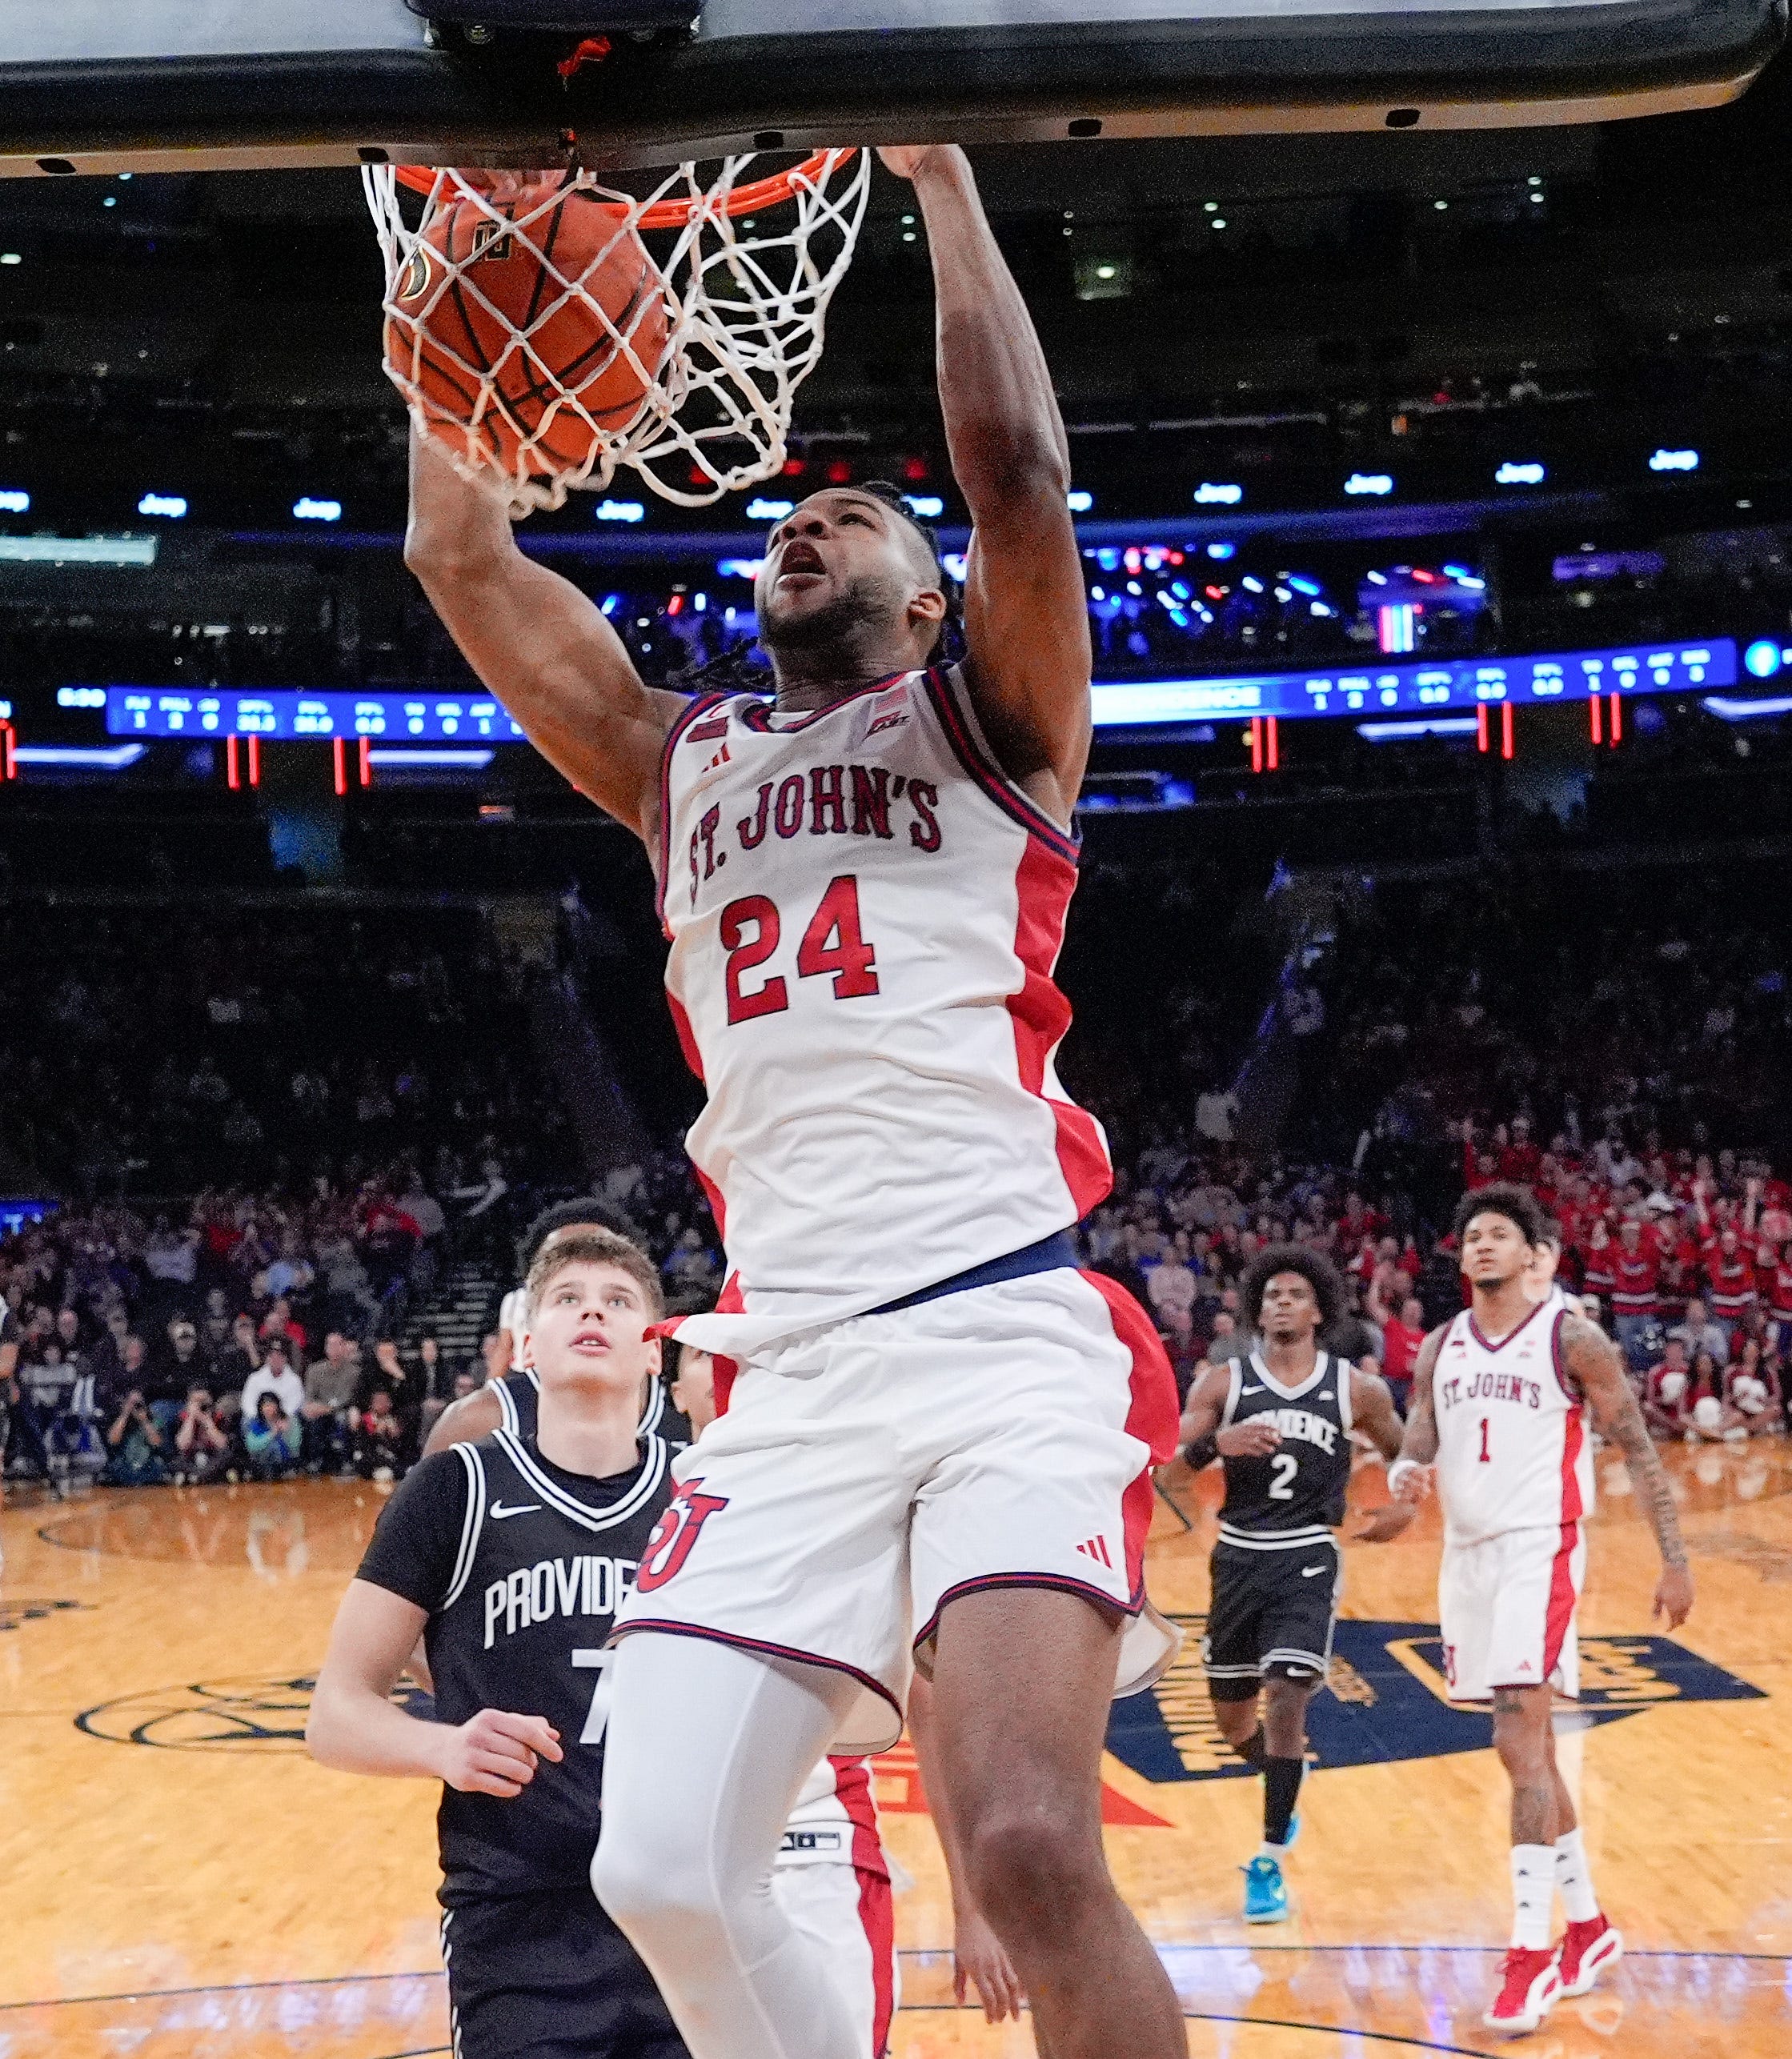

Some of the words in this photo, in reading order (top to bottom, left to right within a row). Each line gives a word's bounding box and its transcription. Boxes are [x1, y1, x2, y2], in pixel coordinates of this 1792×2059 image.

[736, 765, 941, 852] JOHN'S
[719, 875, 880, 1026] 24
[1467, 1372, 1541, 1410] JOHN'S
[1269, 1453, 1298, 1500] 2
[1479, 1418, 1490, 1462] 1
[484, 1555, 642, 1649] PROVIDE
[571, 1648, 616, 1744] 7
